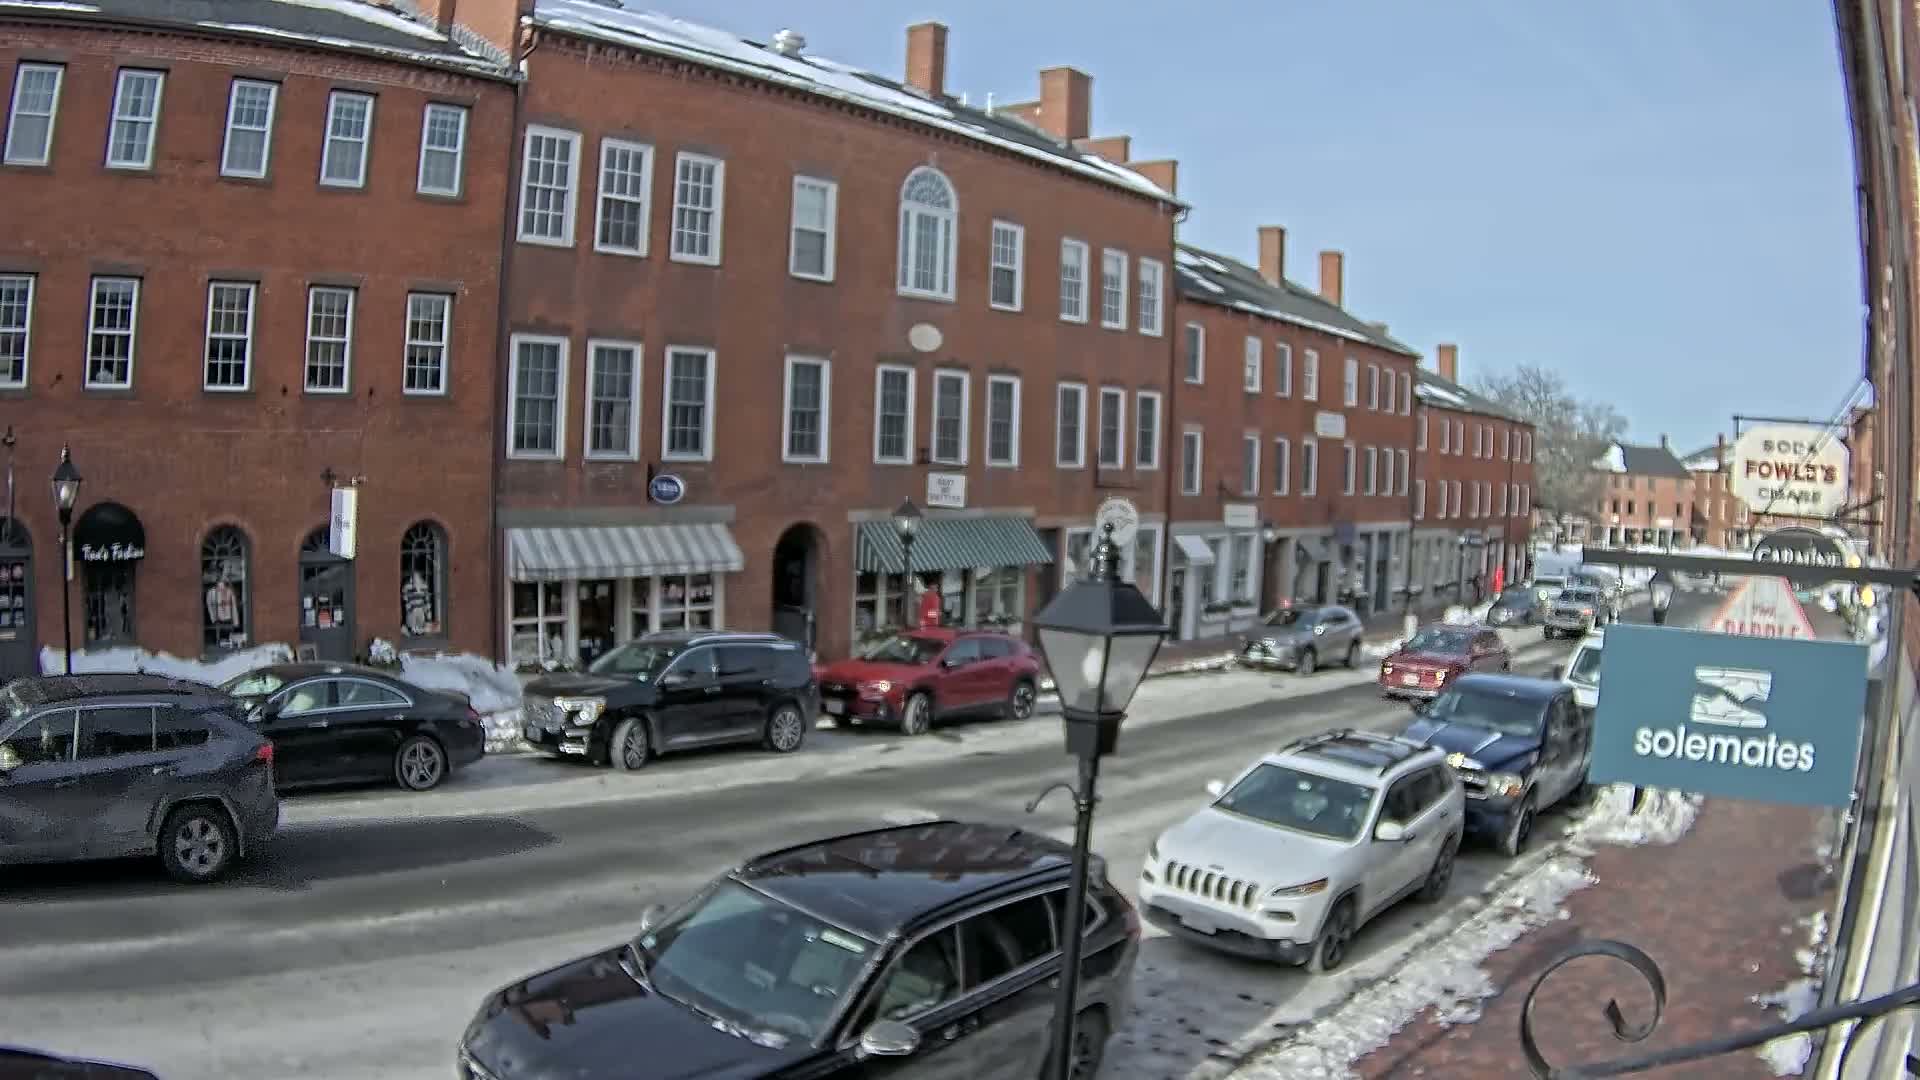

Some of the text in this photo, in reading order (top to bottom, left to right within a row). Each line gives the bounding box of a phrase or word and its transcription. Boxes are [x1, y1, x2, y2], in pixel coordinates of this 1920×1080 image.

[1763, 439, 1819, 454] SODA
[1745, 459, 1838, 482] FOWLE'S
[1634, 722, 1815, 773] solemates
